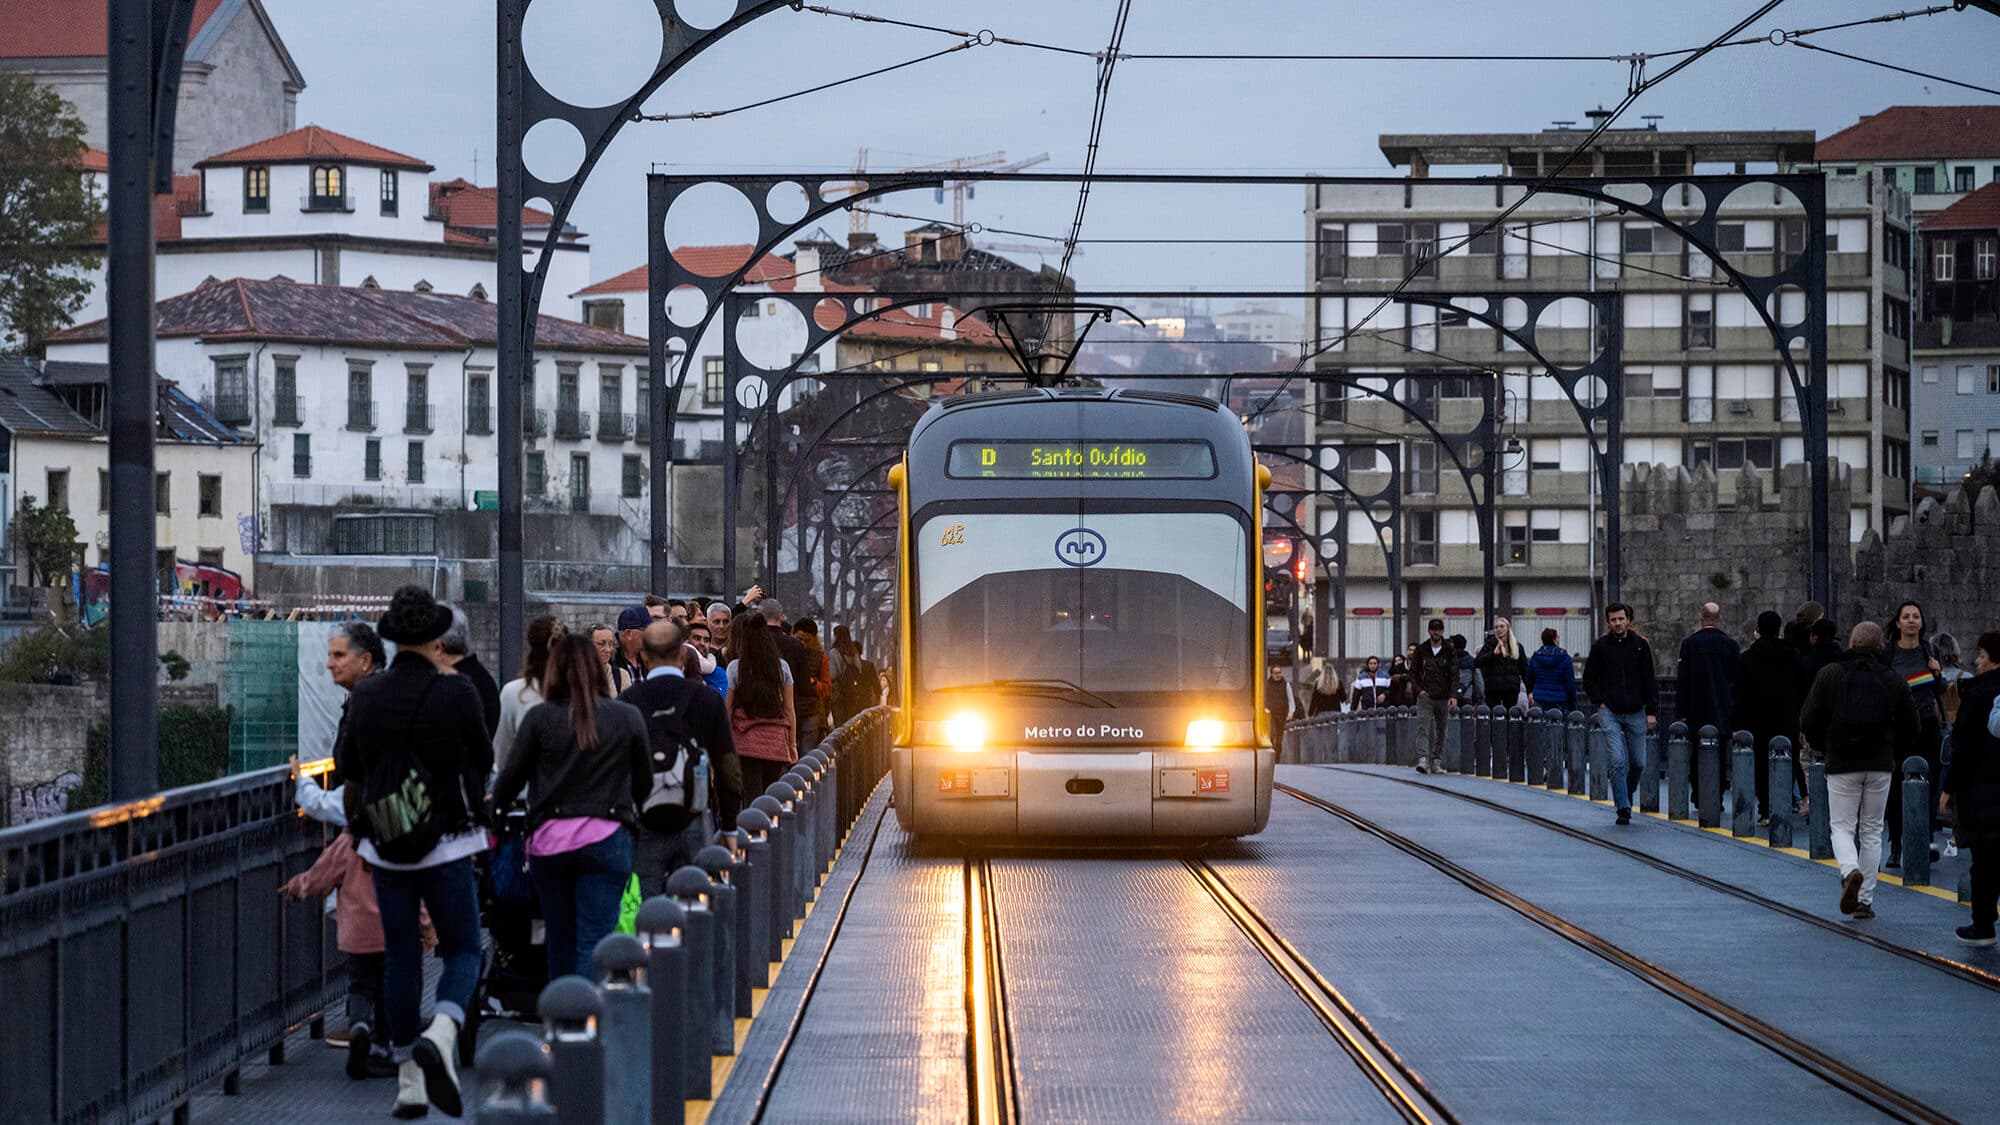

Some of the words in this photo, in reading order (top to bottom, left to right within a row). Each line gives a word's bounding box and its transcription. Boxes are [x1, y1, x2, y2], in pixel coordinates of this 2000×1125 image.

[981, 448, 997, 465] D
[1031, 448, 1083, 466] Santo
[1090, 446, 1147, 466] Ovídio
[1024, 726, 1072, 739] Metro
[1076, 725, 1096, 737] do
[1100, 725, 1144, 738] Porto
